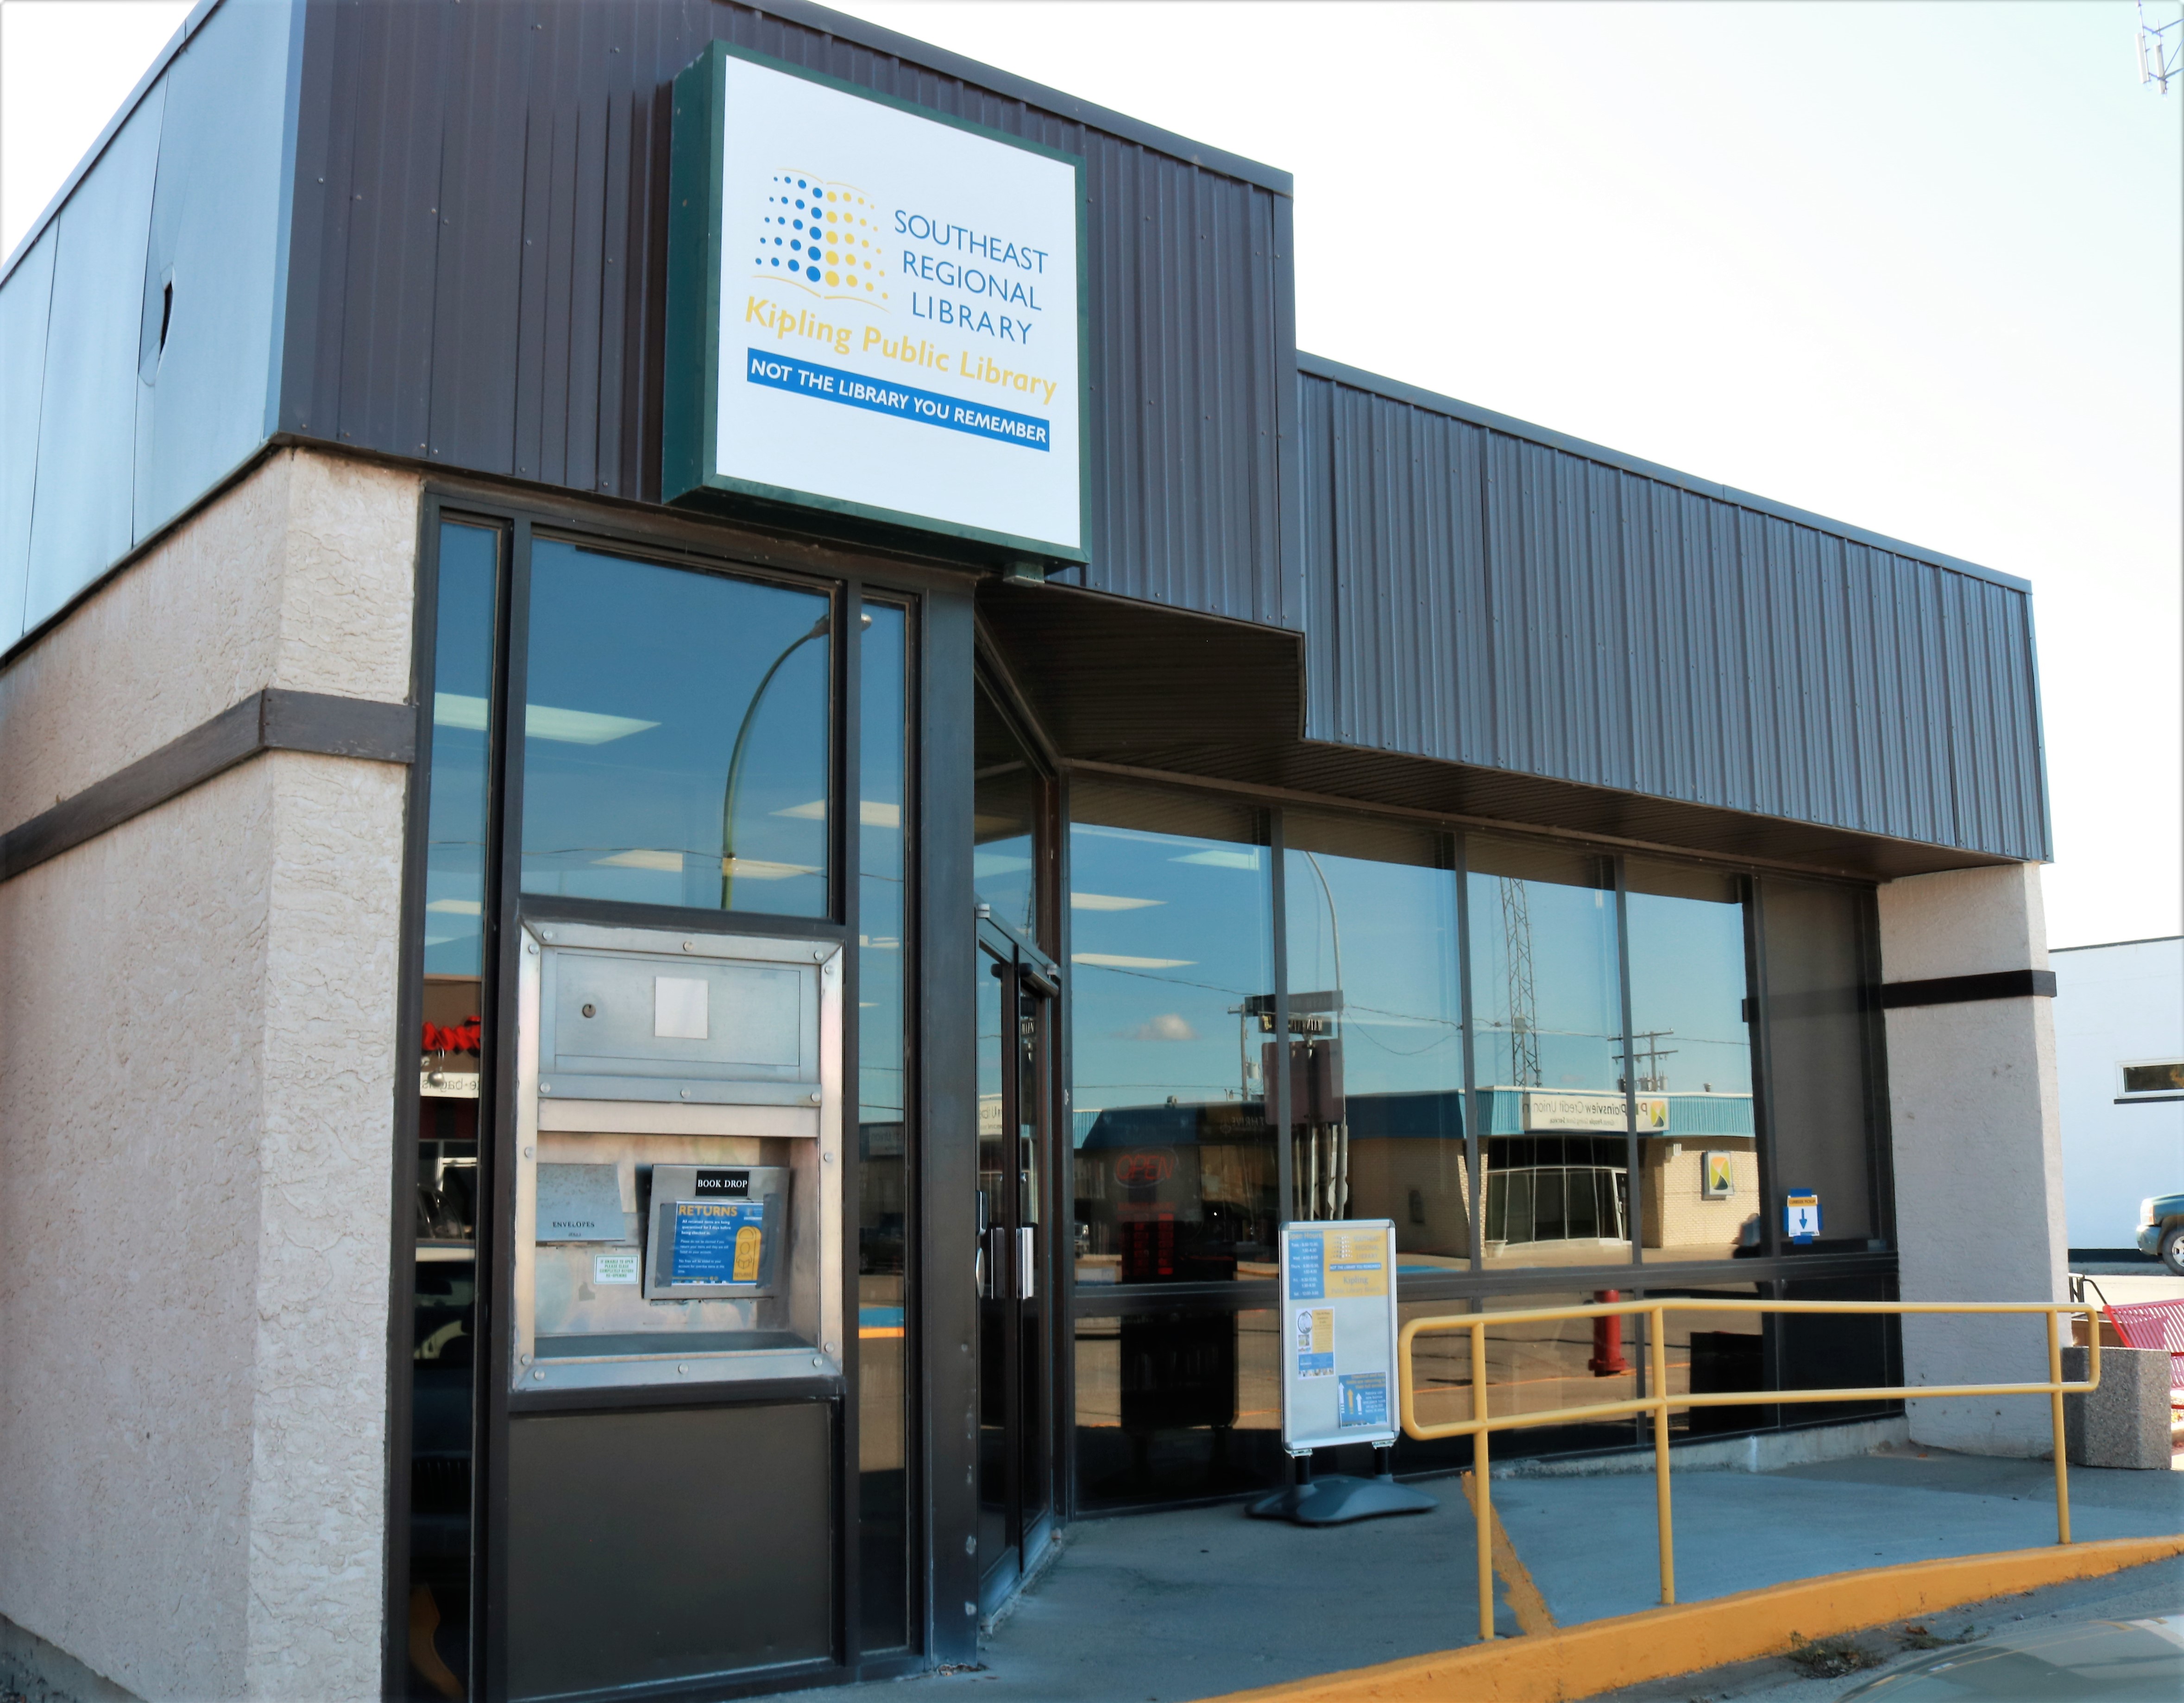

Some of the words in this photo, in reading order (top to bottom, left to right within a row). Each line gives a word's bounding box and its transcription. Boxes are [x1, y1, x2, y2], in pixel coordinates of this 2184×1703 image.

[894, 210, 1049, 274] SOUTHEAST
[903, 251, 1042, 311] REGIONAL
[913, 292, 1032, 345] LIBRARY
[745, 296, 853, 355] Kipling
[862, 326, 950, 373] Public
[960, 351, 1057, 405] Library
[751, 358, 793, 381] NOT
[799, 370, 834, 392] THE
[839, 379, 909, 410] LIBRARY
[913, 396, 950, 419] YOU
[954, 406, 1047, 443] REMEMBER
[698, 1179, 722, 1188] BOOK
[724, 1179, 748, 1188] DROP
[1117, 1154, 1174, 1180] OPEN
[679, 1205, 737, 1216] RETURNS
[1343, 1276, 1368, 1285] Kipling
